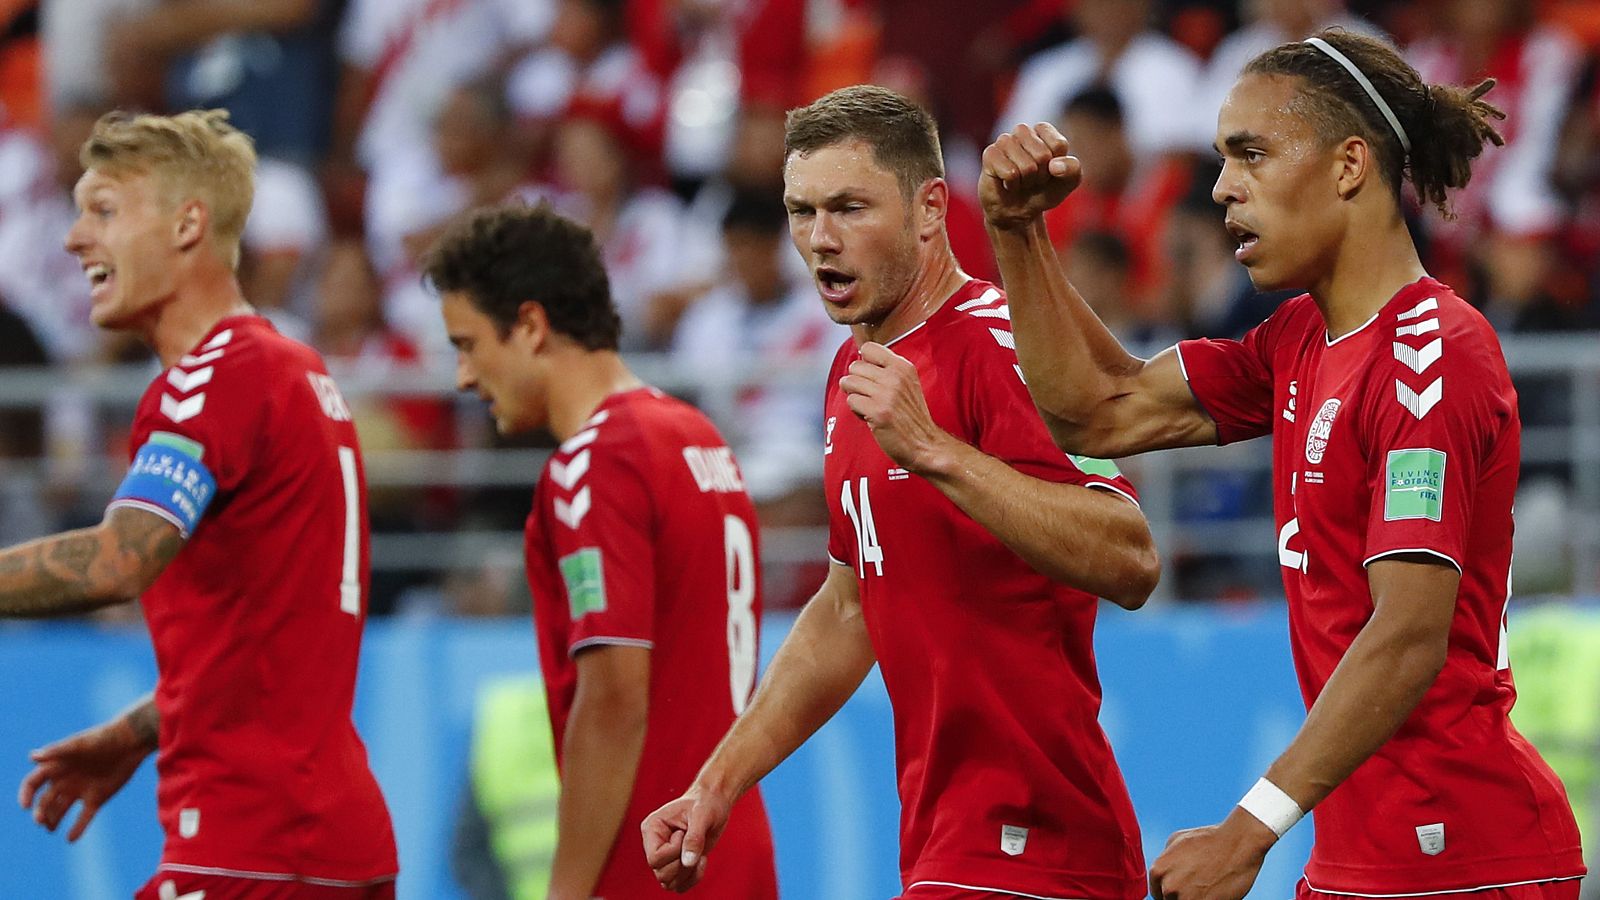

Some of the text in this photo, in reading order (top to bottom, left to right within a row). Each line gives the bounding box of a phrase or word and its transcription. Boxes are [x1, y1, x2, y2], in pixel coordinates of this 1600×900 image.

[1391, 470, 1439, 479] LIVING
[1420, 491, 1437, 501] FIFA
[841, 477, 883, 579] 14
[724, 514, 755, 717] 8
